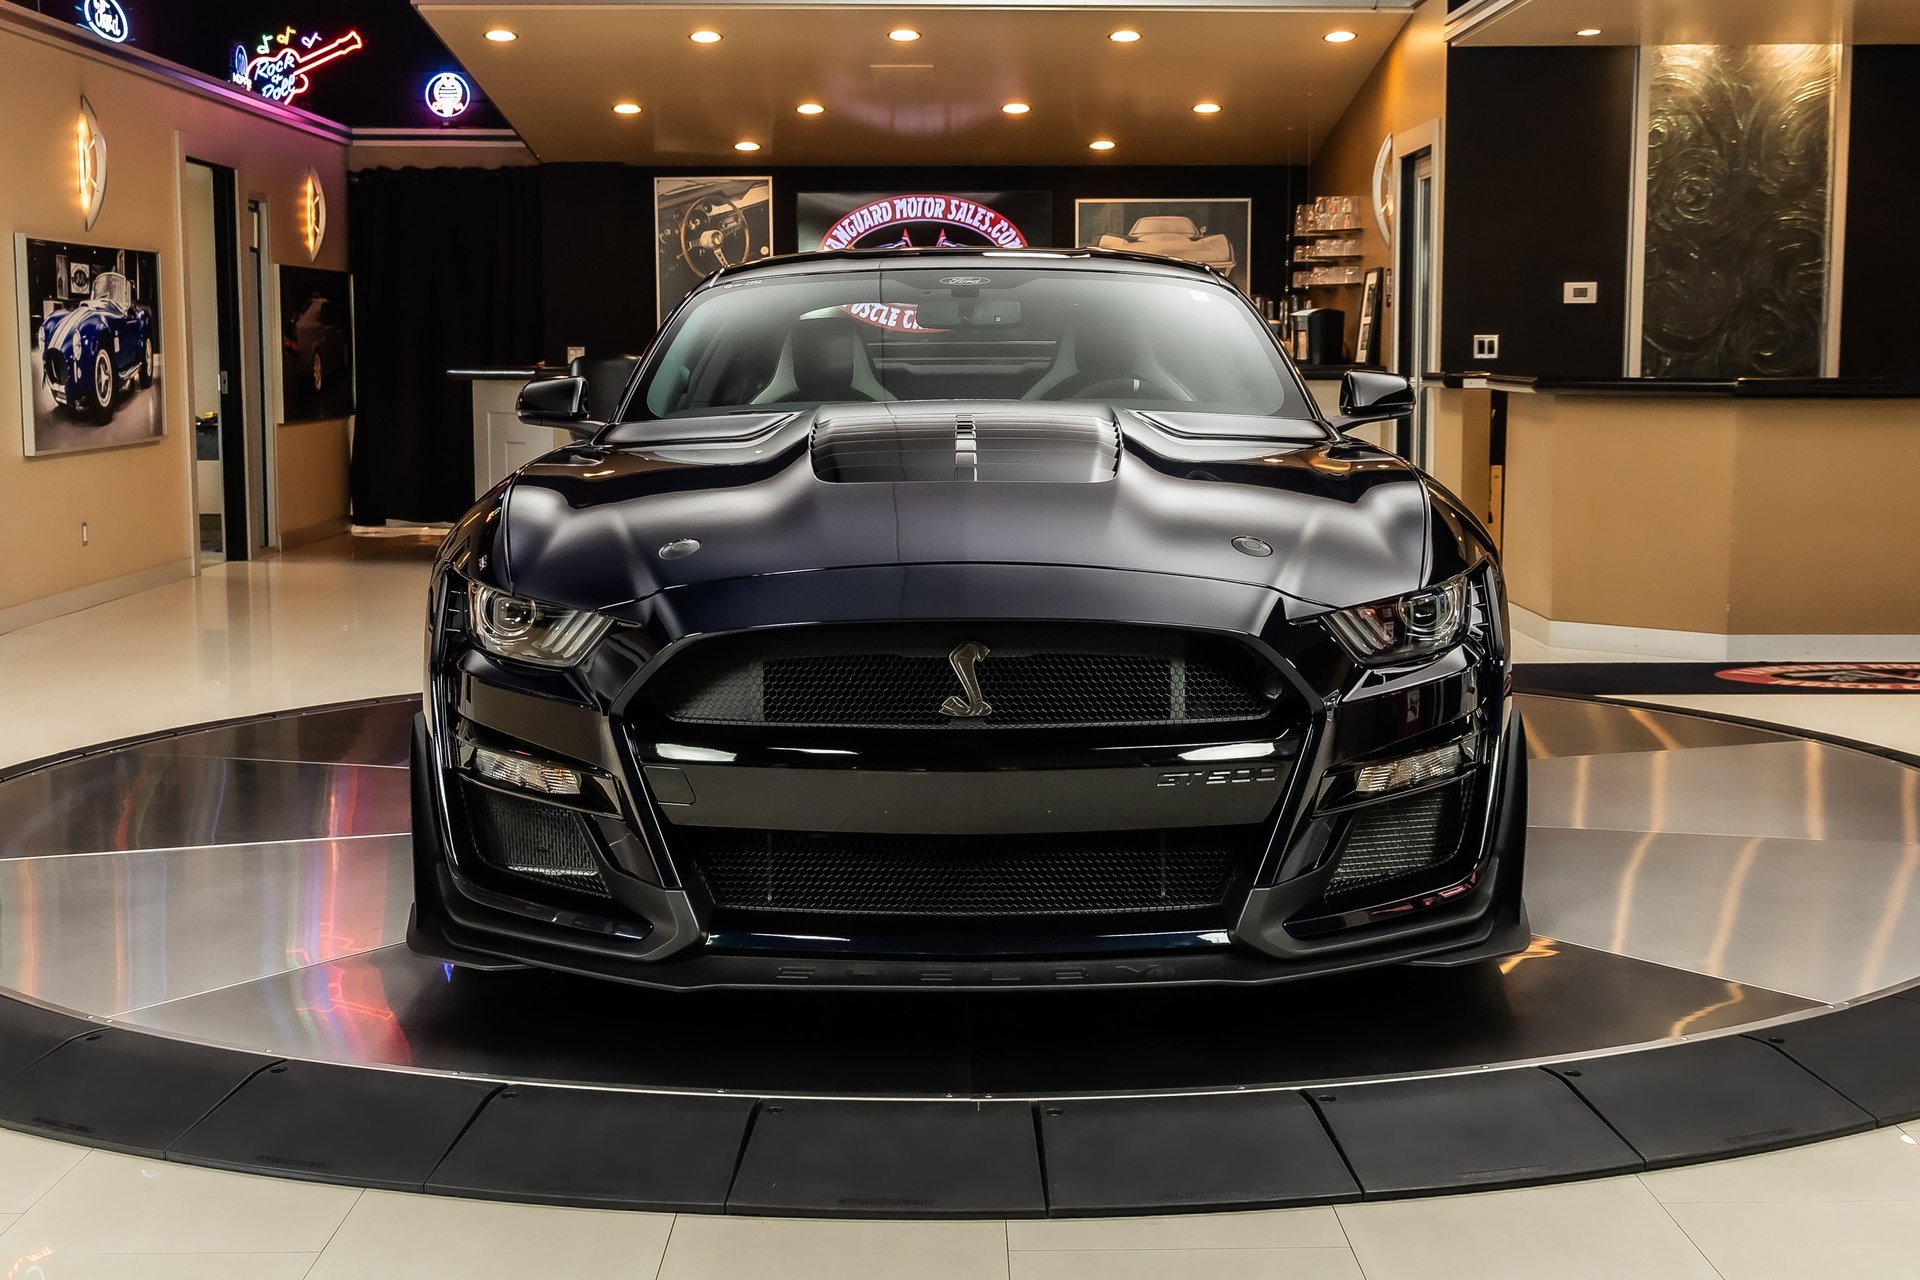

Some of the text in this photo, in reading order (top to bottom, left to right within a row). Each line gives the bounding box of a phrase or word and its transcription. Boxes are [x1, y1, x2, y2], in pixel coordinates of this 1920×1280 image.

[254, 51, 296, 81] Rock
[824, 200, 893, 250] ANGUARD
[893, 197, 946, 219] MOTOR
[848, 303, 900, 327] USCLE
[775, 964, 1160, 982] SHELBY
